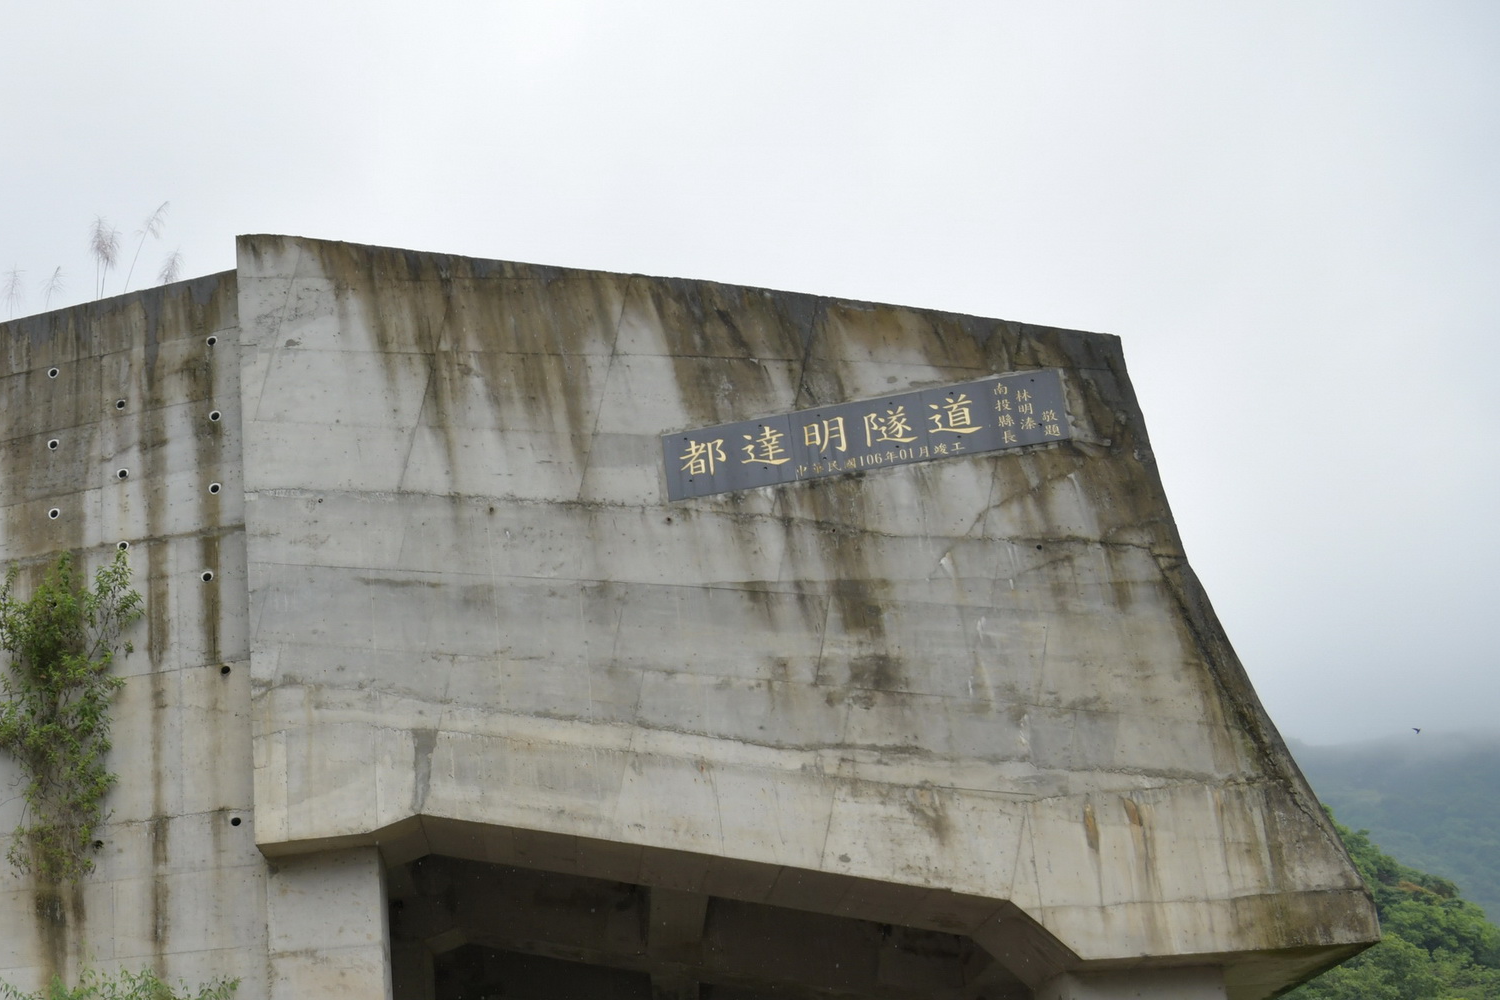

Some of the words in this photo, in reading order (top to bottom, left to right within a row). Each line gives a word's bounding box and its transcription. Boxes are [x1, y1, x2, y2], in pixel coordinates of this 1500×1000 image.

[993, 383, 1017, 443] 南投縣長
[1016, 389, 1036, 430] 林明溱
[1042, 409, 1060, 437] 敬題
[680, 394, 983, 476] 都達明隧道
[795, 442, 966, 478] 中華民國106年01月竣工
